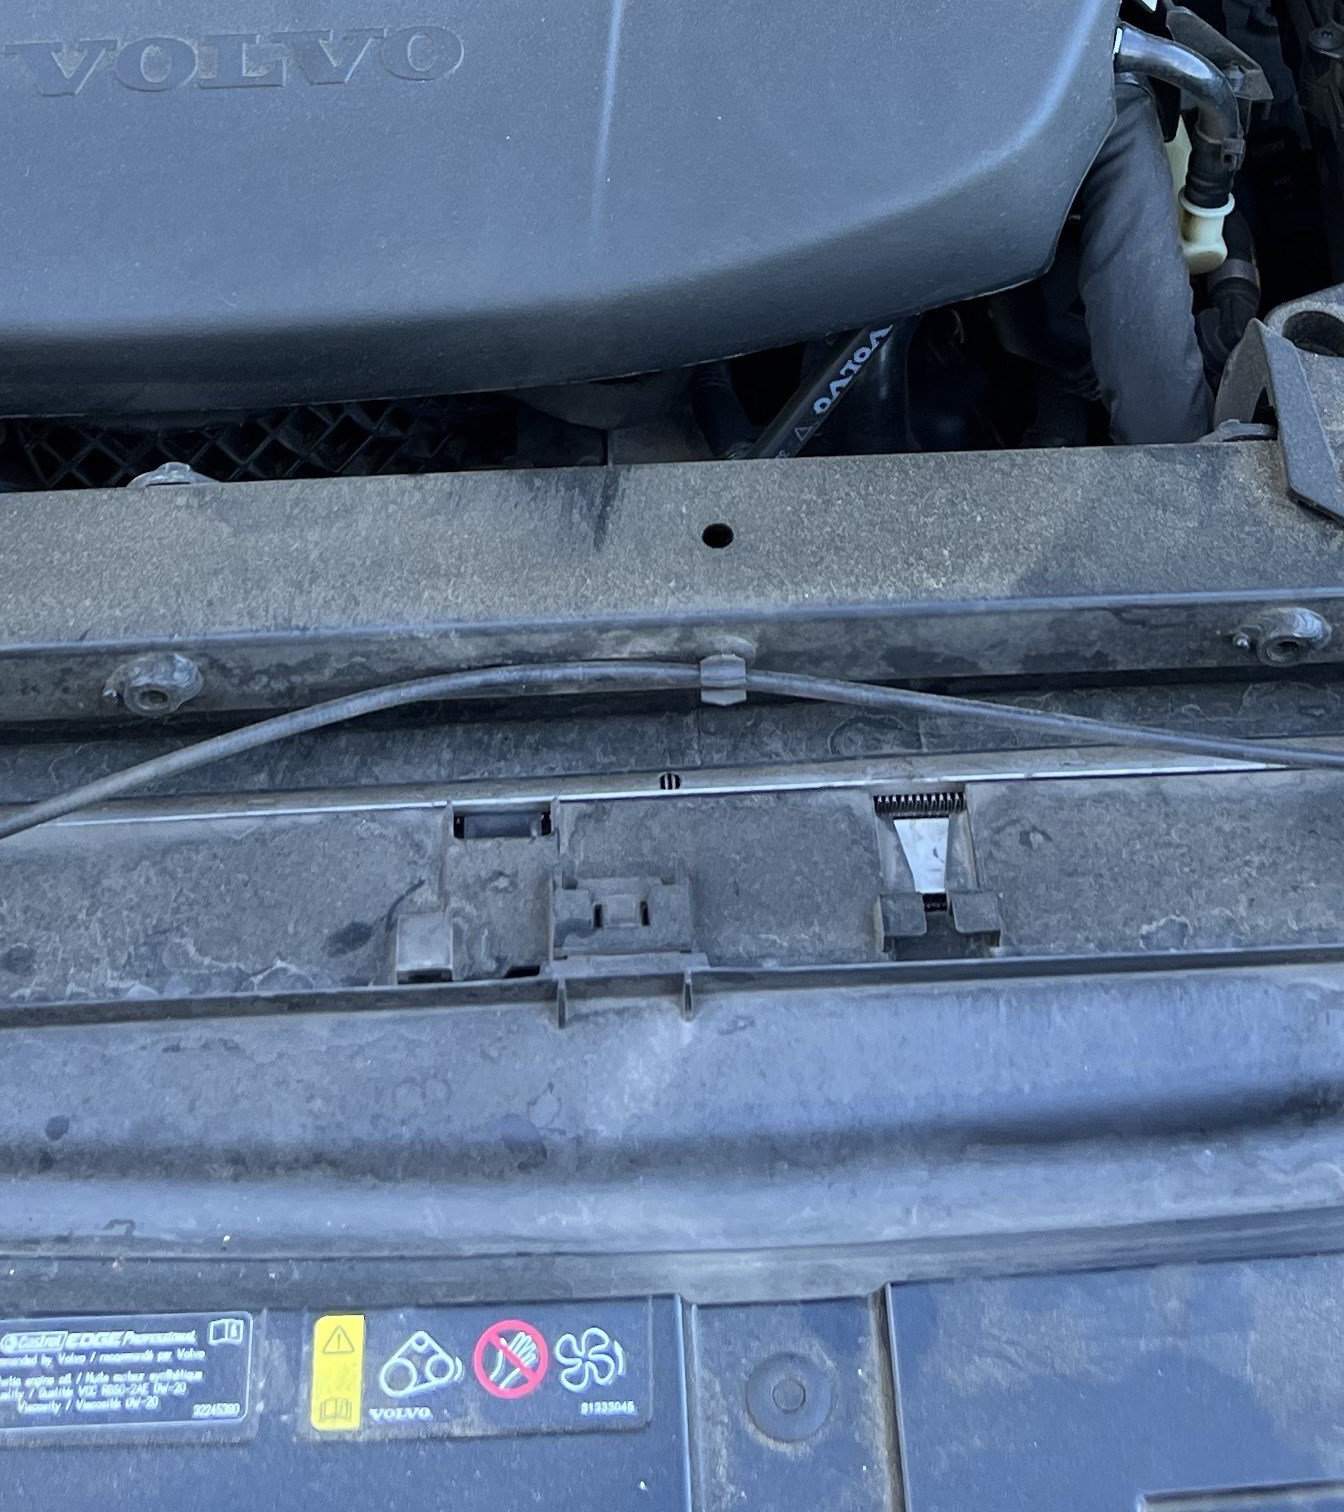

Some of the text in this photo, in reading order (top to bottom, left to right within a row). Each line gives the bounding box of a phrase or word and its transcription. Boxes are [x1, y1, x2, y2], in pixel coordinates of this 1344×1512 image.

[4, 25, 465, 97] VOLVO
[65, 1331, 125, 1348] EDGE
[41, 1354, 53, 1368] by
[58, 1353, 86, 1365] Volvo
[176, 1348, 205, 1361] Volvo
[369, 1407, 432, 1420] VOLVO
